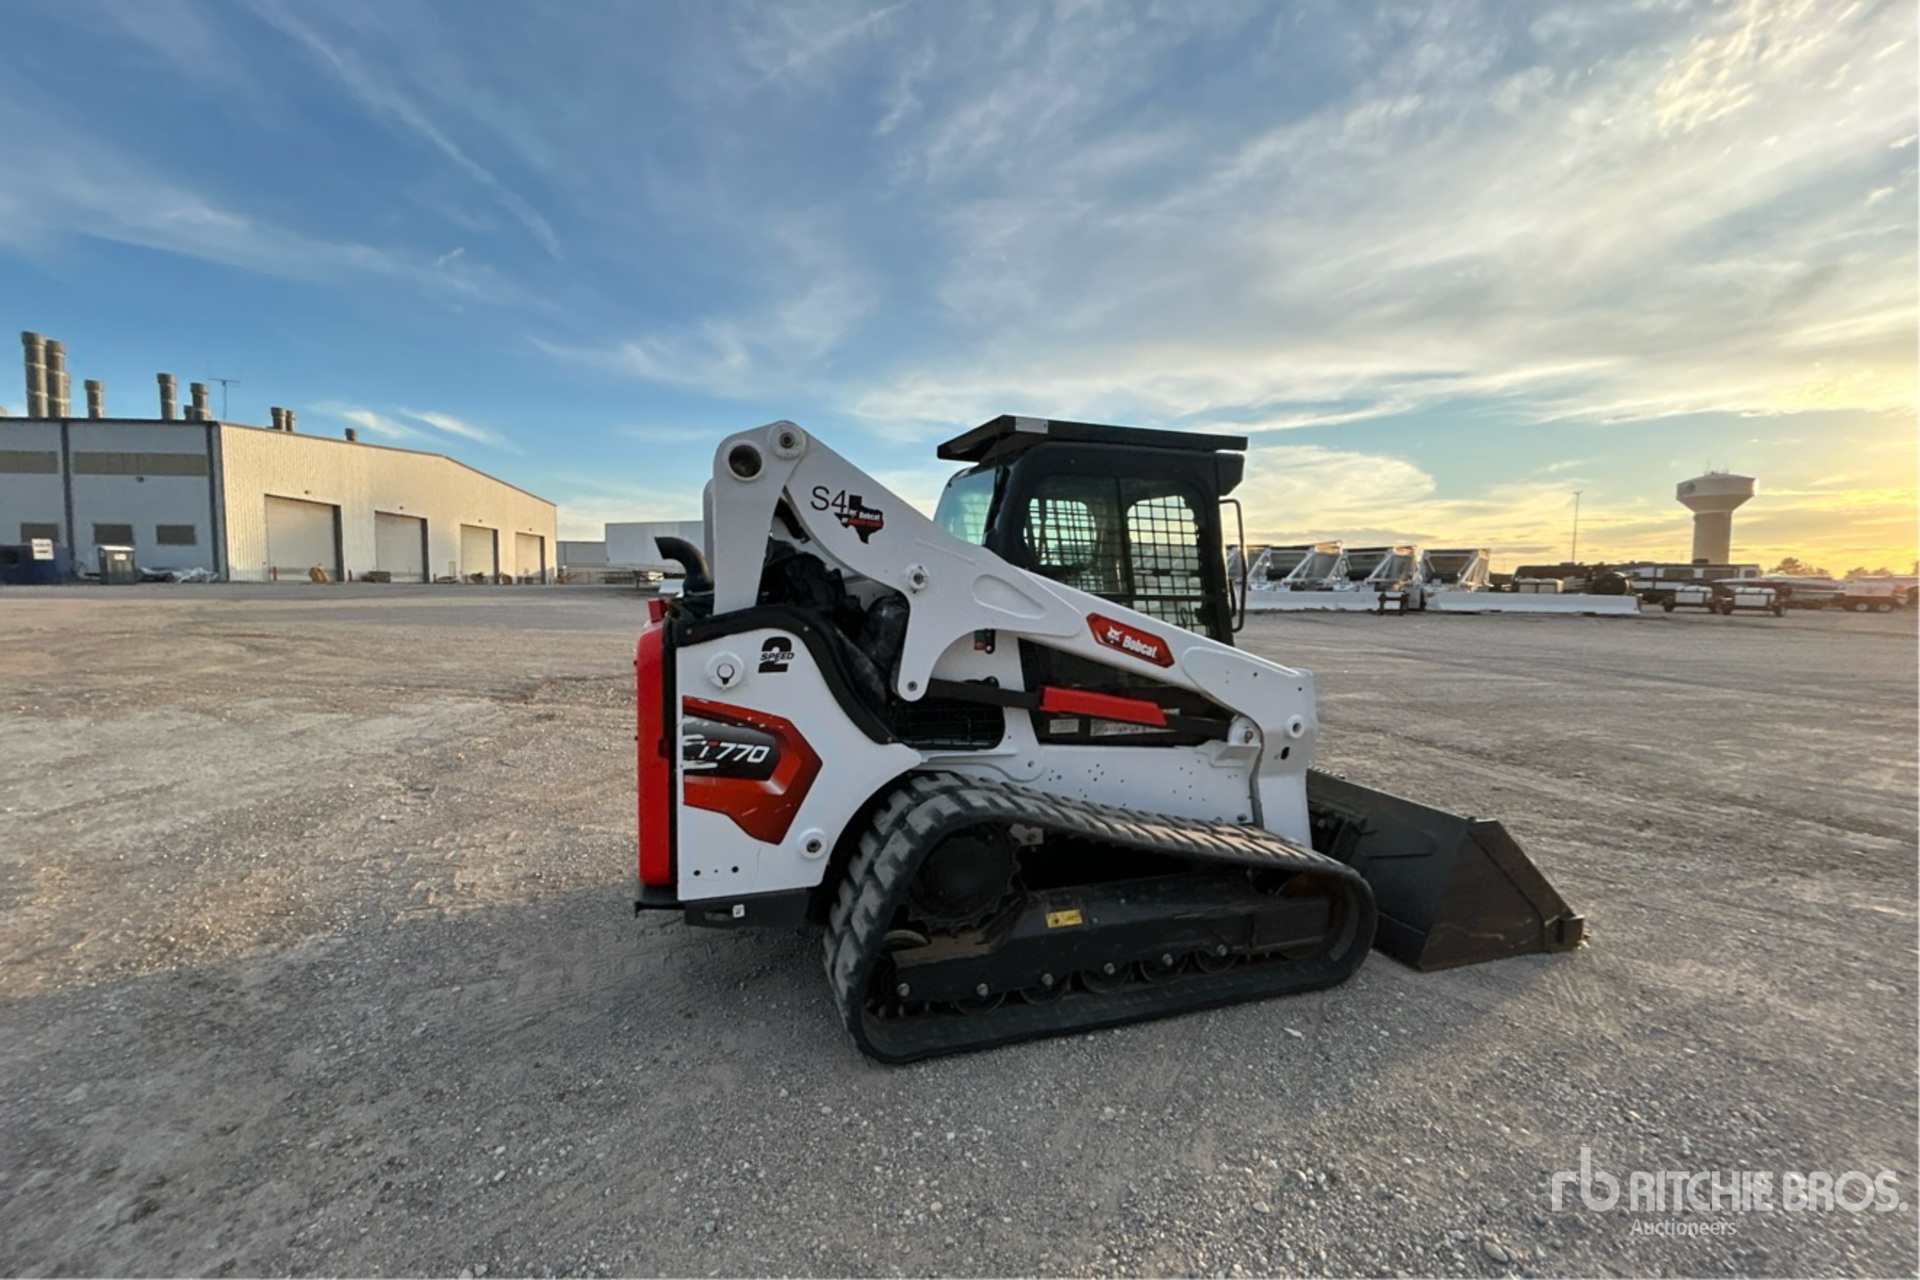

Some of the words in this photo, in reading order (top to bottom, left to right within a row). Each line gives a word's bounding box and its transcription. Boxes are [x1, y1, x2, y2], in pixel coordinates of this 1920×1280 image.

[810, 485, 847, 513] S4
[760, 652, 795, 661] SPEED
[1122, 635, 1158, 658] Bobcat
